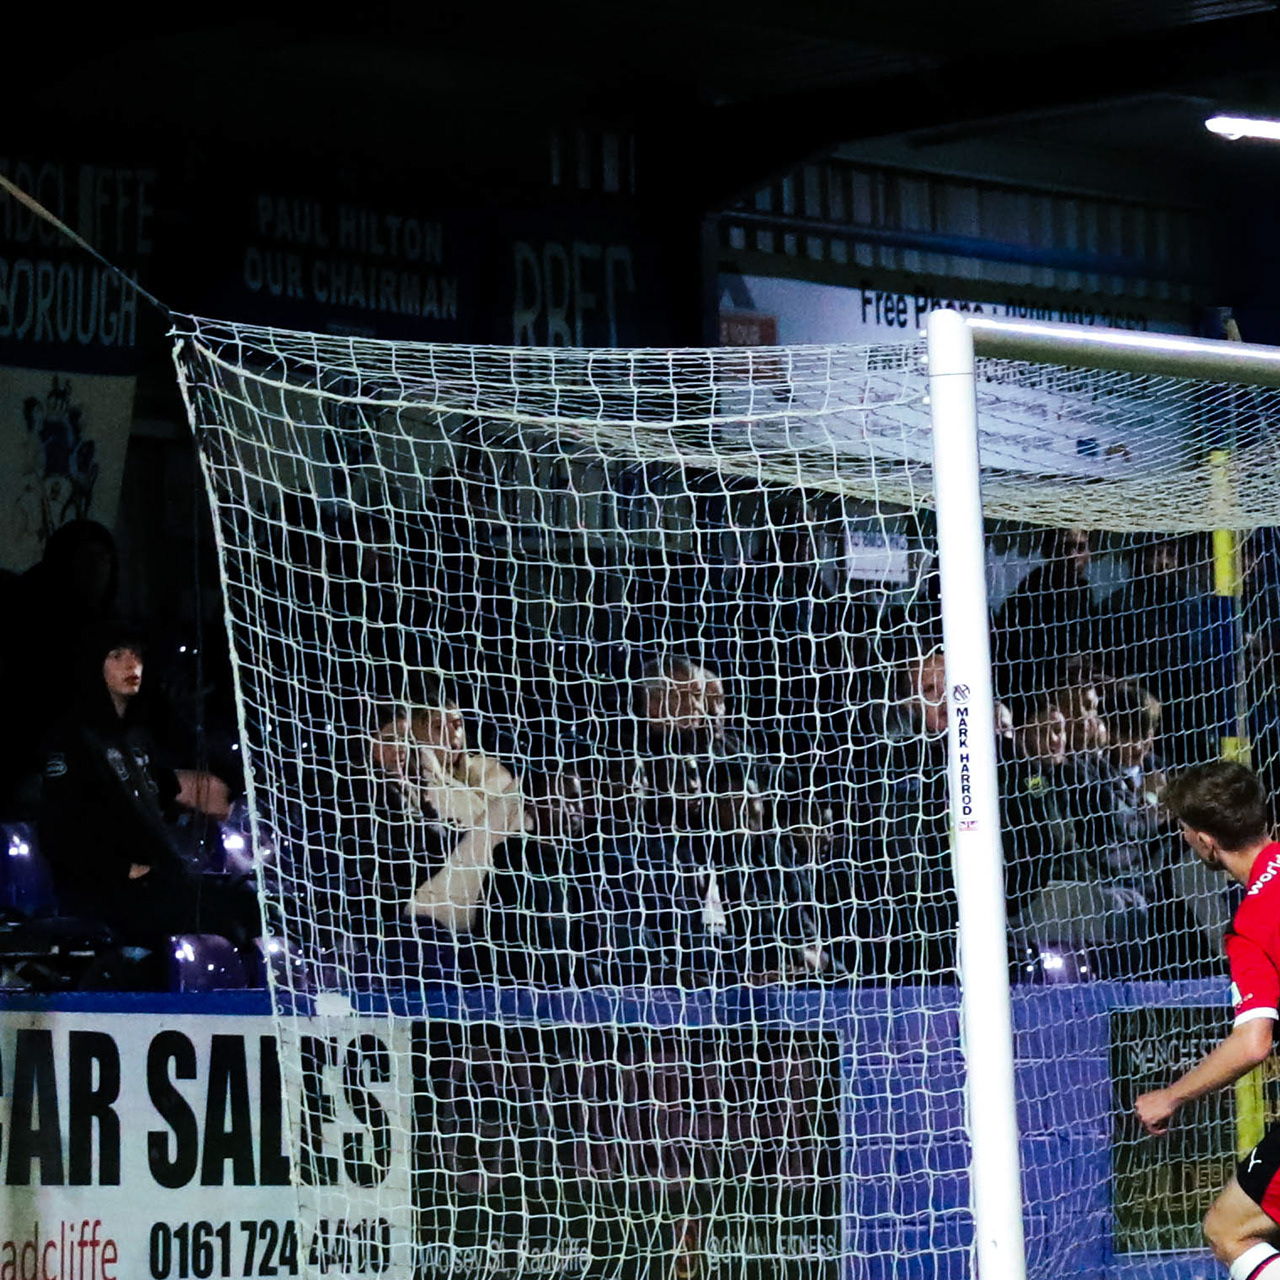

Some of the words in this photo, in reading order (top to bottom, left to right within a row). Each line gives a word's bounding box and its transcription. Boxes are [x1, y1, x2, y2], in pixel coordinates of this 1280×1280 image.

[256, 192, 330, 249] PAUL
[337, 202, 444, 264] HILTON
[242, 243, 304, 297] OUR
[311, 258, 458, 320] CHAIRMAN
[863, 280, 907, 329] Free
[956, 707, 969, 748] MARK
[960, 753, 972, 816] HARROD
[0, 1029, 121, 1186] AR
[146, 1030, 392, 1189] SALES
[149, 1220, 232, 1280] 0161
[240, 1219, 299, 1277] 724
[517, 1236, 591, 1272] Radcliffe
